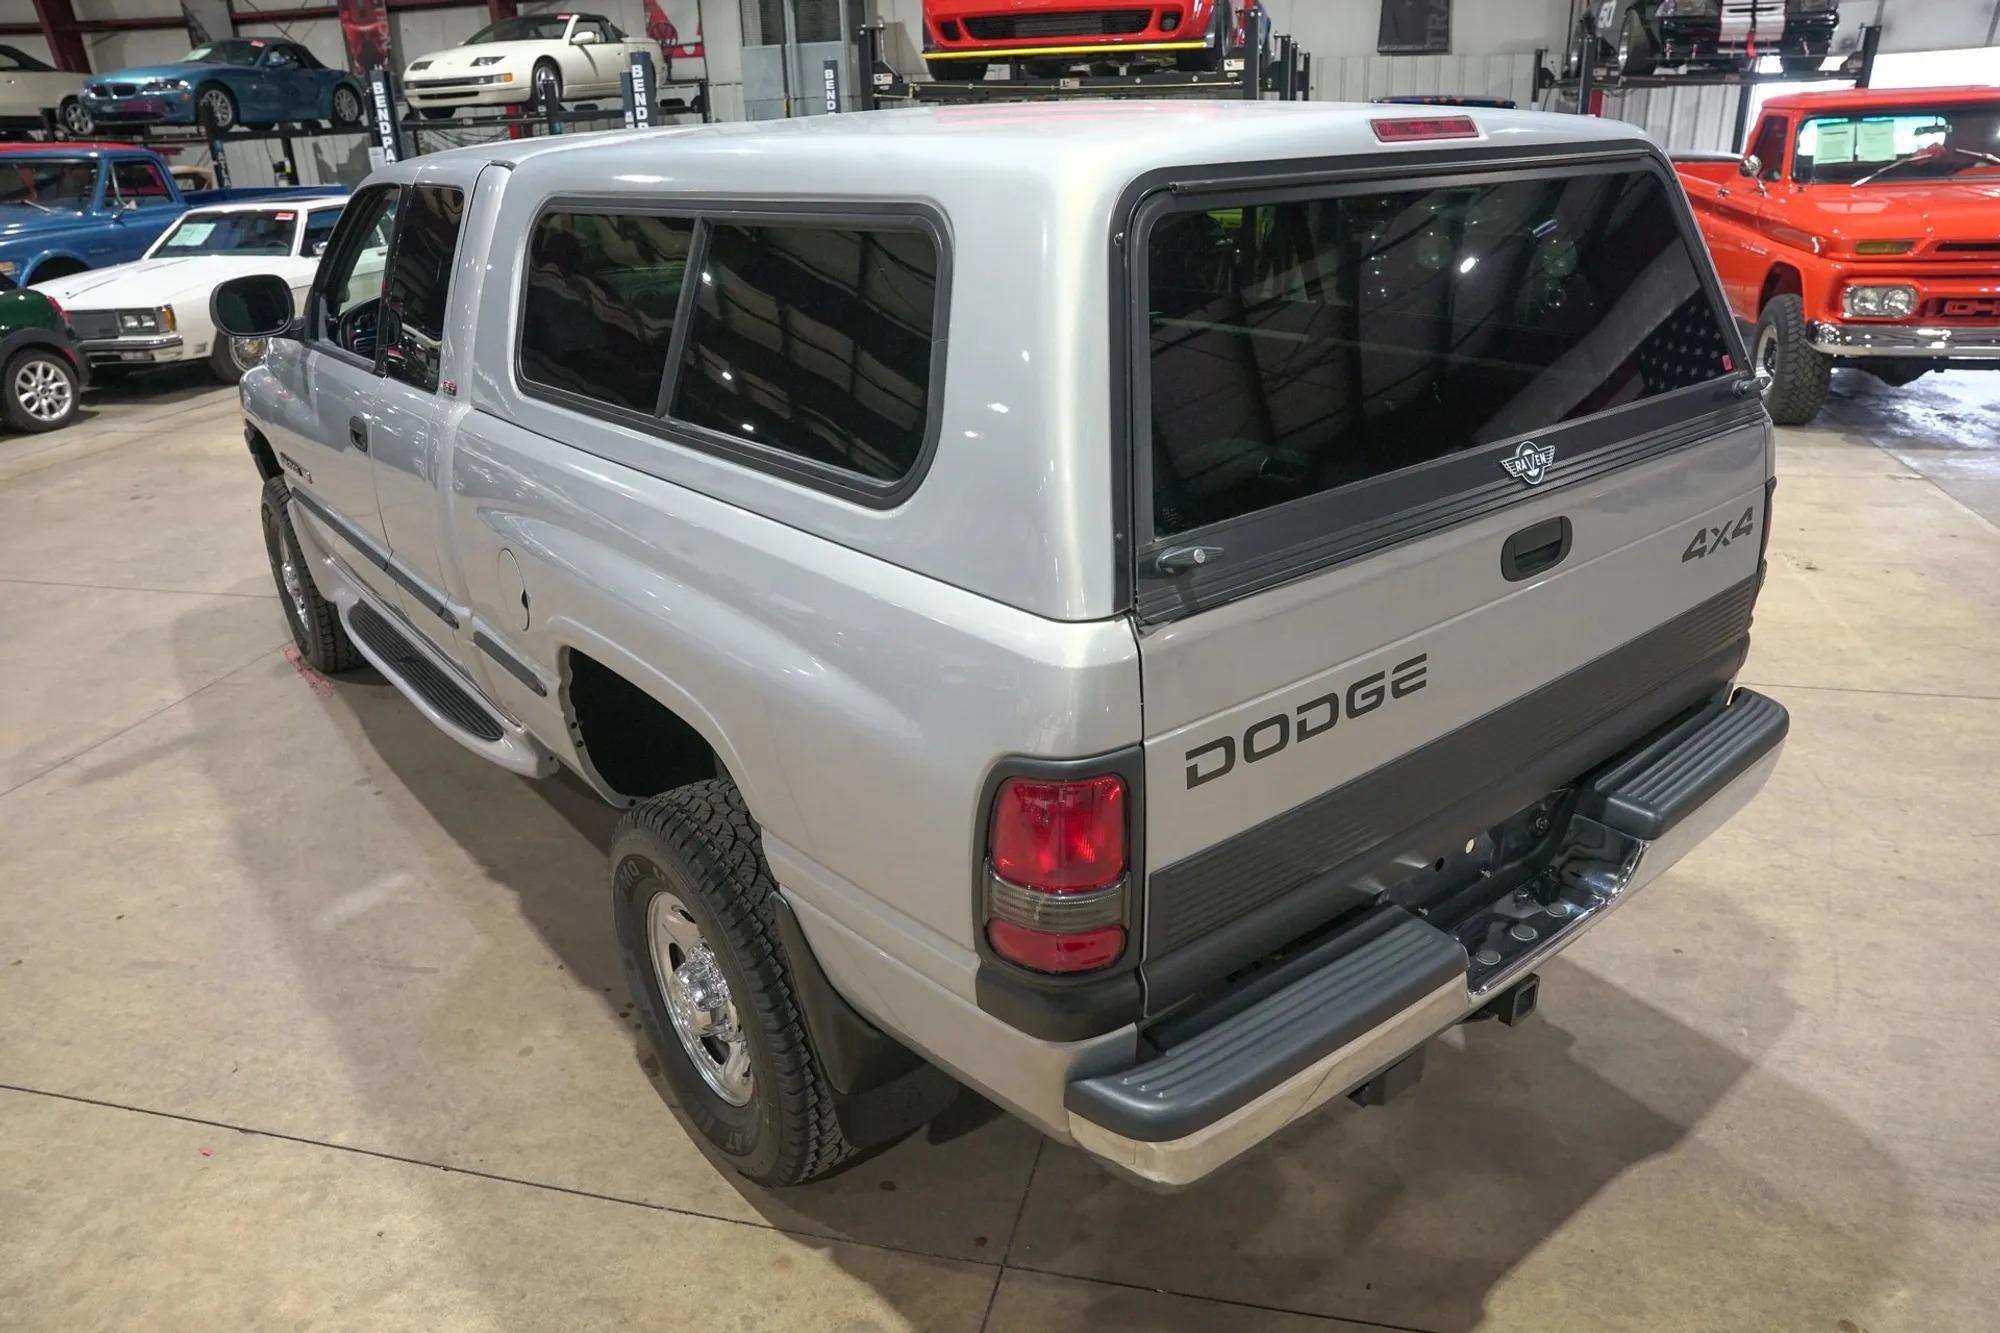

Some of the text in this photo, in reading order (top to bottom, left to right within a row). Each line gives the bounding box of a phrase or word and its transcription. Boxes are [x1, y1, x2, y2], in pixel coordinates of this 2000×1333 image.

[372, 82, 397, 165] BENDPA
[825, 69, 836, 115] BEND
[1514, 452, 1547, 472] RAVEN
[1185, 653, 1427, 790] DODGE
